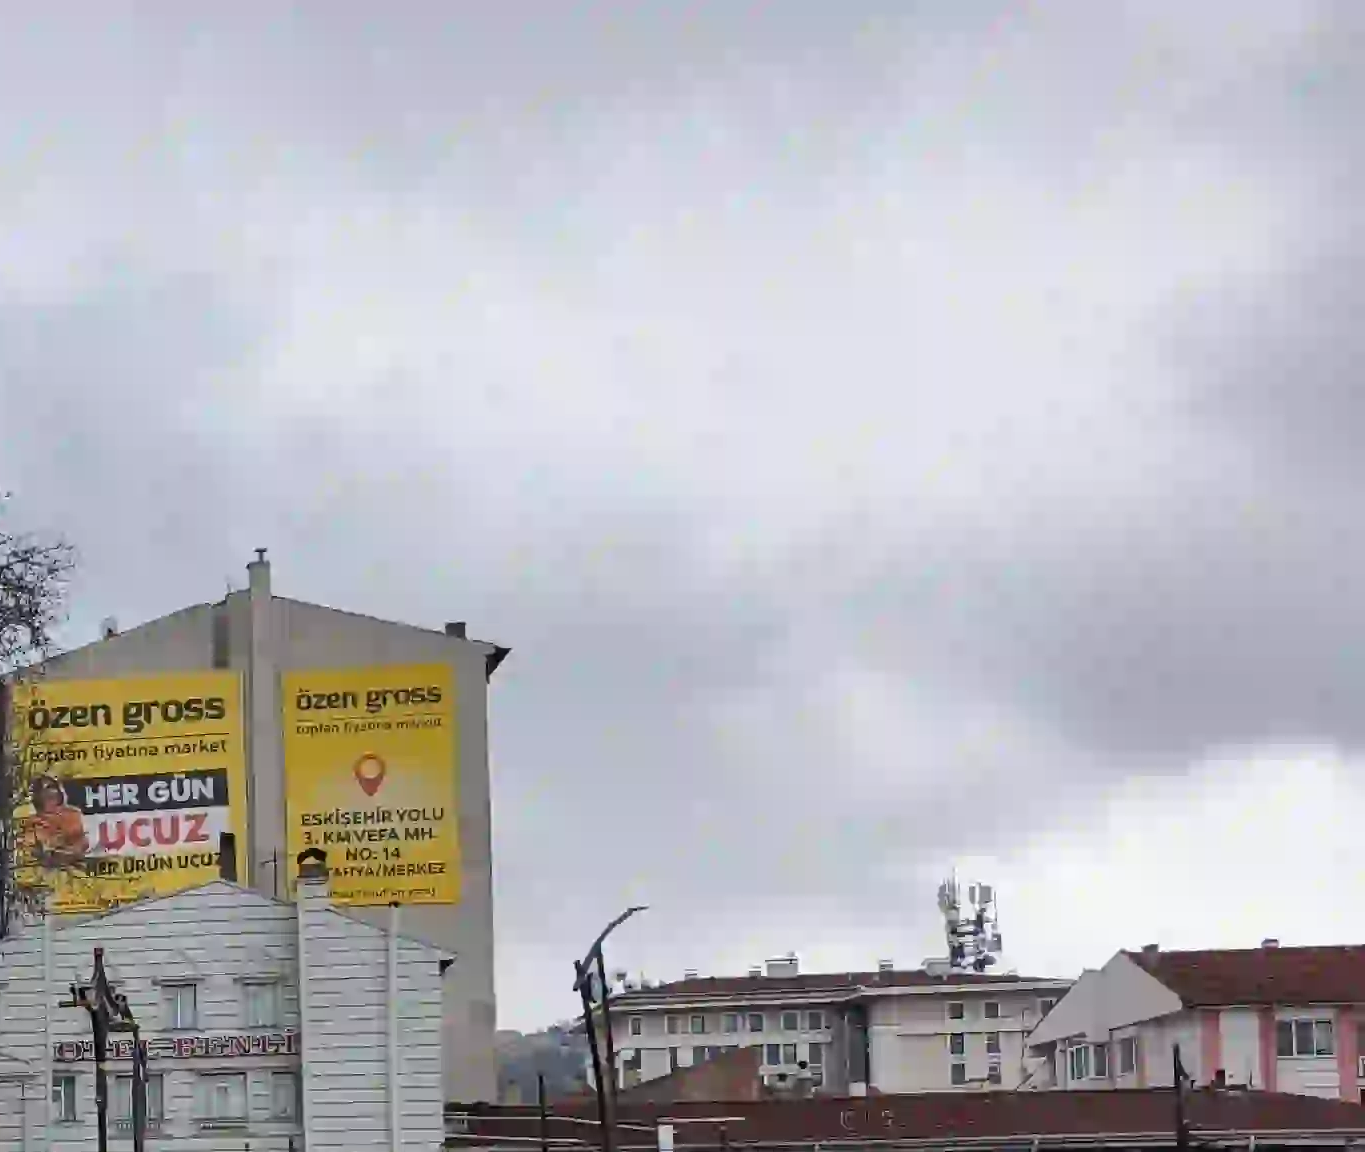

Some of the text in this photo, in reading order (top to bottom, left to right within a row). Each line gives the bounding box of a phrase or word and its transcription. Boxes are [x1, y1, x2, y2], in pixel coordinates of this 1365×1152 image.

[296, 685, 442, 713] özen gross
[29, 697, 226, 734] özen gross
[164, 739, 227, 755] market
[84, 773, 215, 808] HER GÜN
[301, 805, 445, 828] ESKİŞEHİR YOLU
[98, 812, 210, 850] UCUZ
[304, 831, 319, 845] 3.
[353, 826, 400, 843] VEFA
[123, 853, 172, 875] ÜRÜN
[177, 848, 221, 869] UCUZ
[346, 846, 402, 861] NO: 14
[172, 1026, 298, 1058] BENLİ
